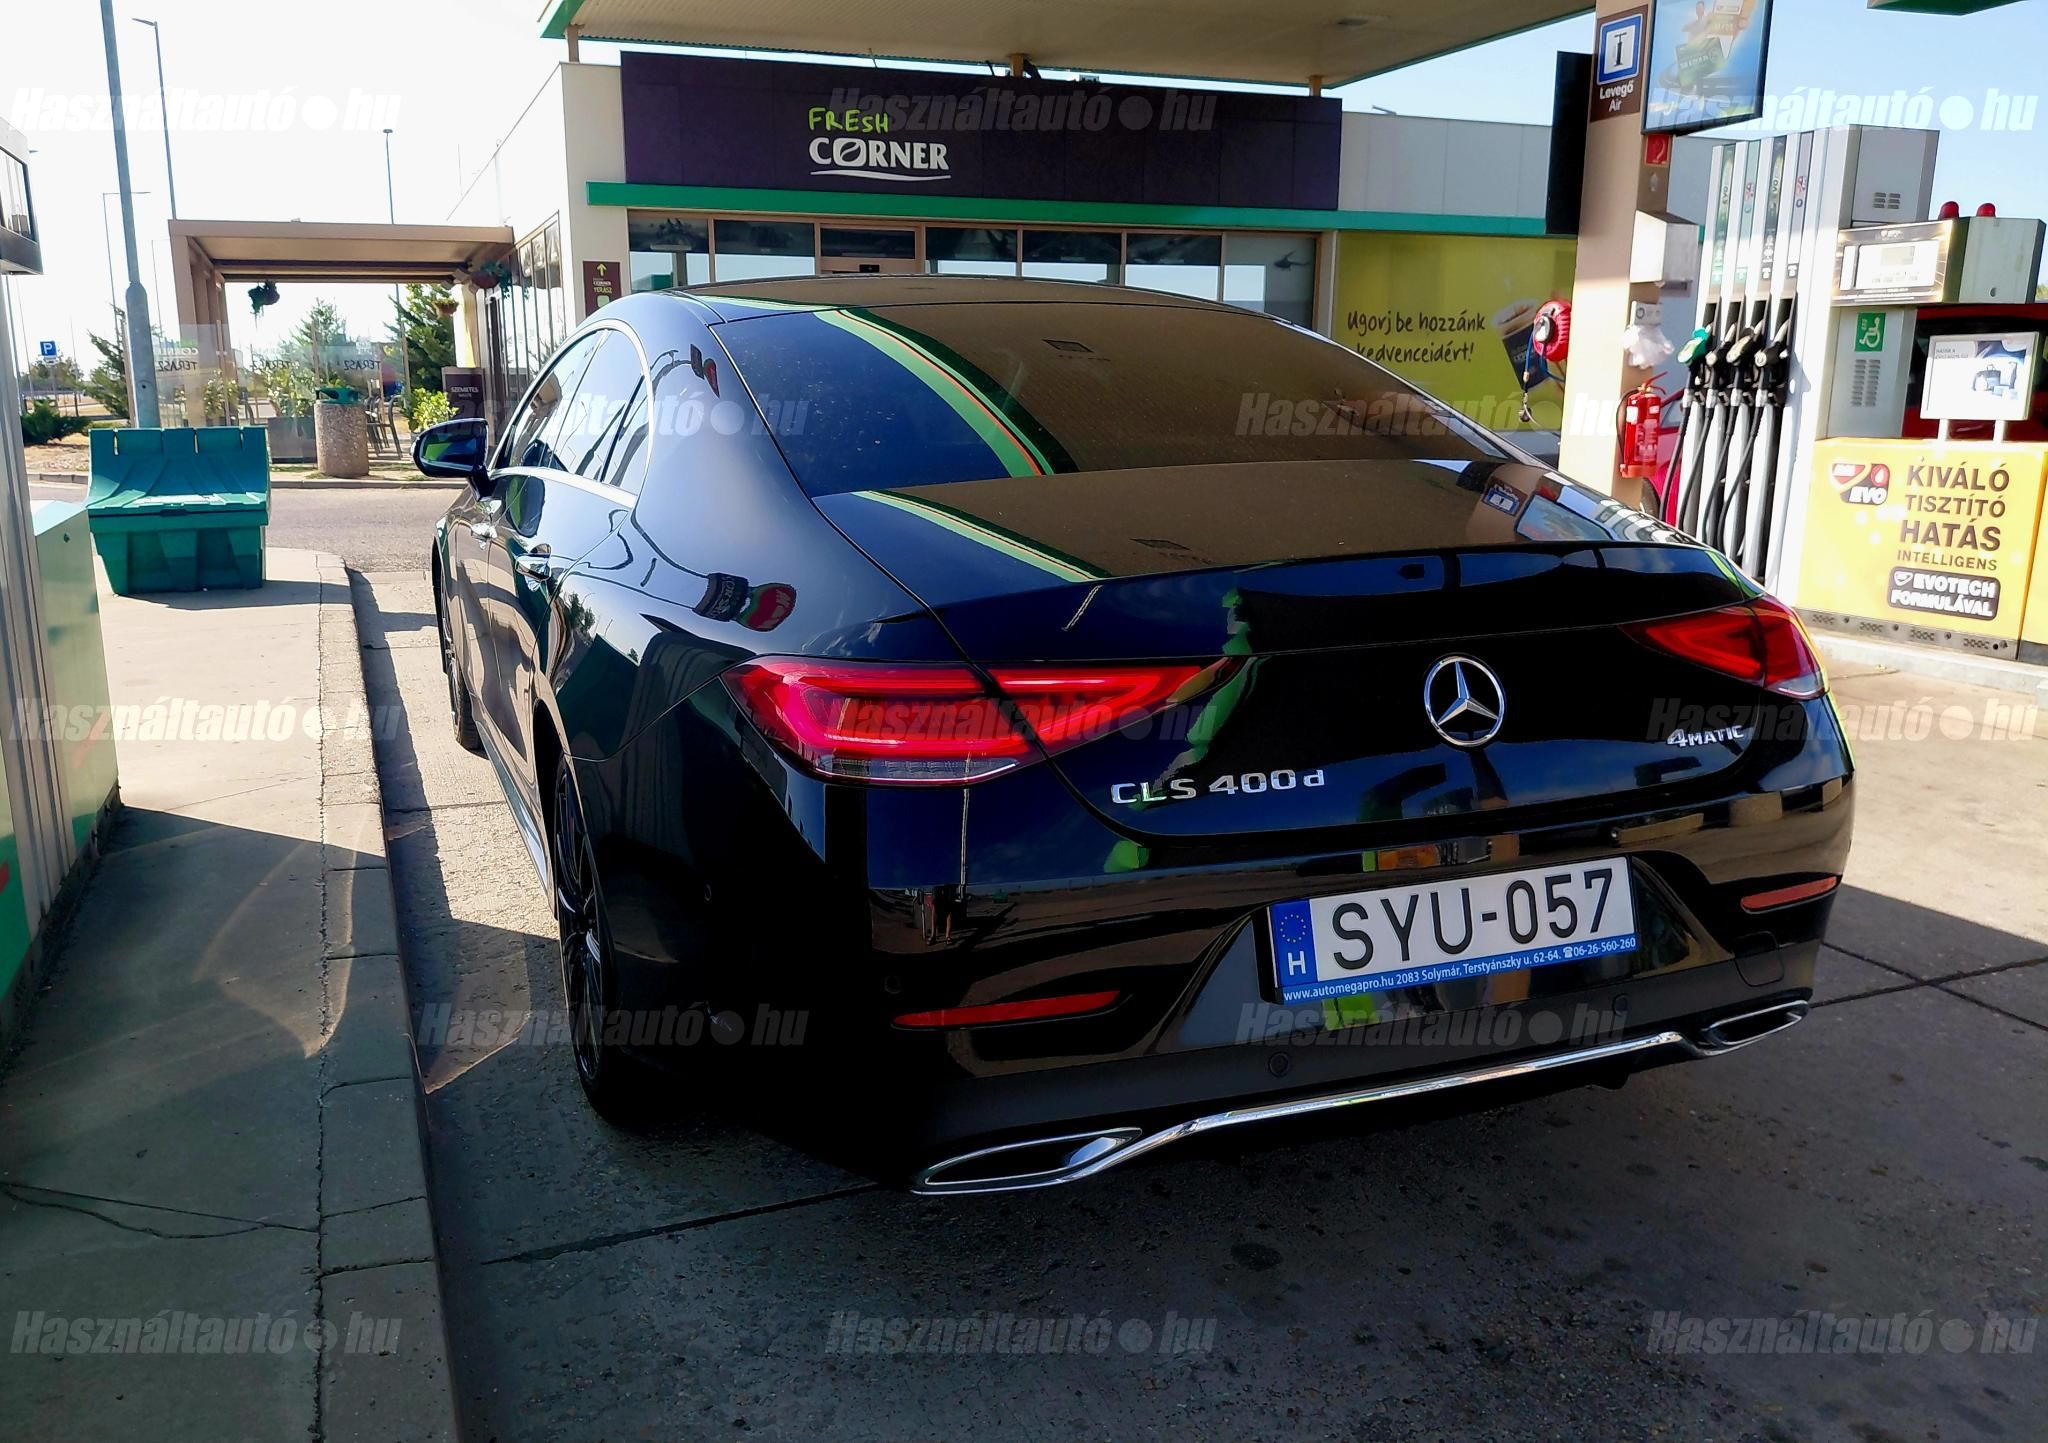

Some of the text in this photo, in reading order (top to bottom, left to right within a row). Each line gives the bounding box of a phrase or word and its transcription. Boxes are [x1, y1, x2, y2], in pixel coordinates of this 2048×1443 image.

[1600, 80, 1634, 100] Levegő
[1608, 99, 1623, 112] Air
[808, 107, 889, 134] FRESH
[808, 137, 950, 170] CORNER
[1347, 310, 1486, 337] Ugorj be hozzánk
[43, 342, 53, 355] P
[1356, 342, 1475, 363] kedvenceidért!
[1906, 461, 2010, 492] KIVÁLÓ
[1904, 493, 2006, 518] TISZTÍTÓ
[1899, 518, 2001, 551] HATÁS
[1896, 549, 1998, 571] INTELLIGENS
[1912, 573, 1996, 598] EVOTECH
[1890, 588, 1994, 616] FORMULÁVAL
[1666, 725, 1745, 747] 4MATIC
[1110, 778, 1198, 804] CLS
[1332, 868, 1613, 971] SYU-057
[1283, 975, 1394, 1001] www.automegapro.hu
[1396, 971, 1420, 985] 2083
[1422, 964, 1462, 984] Solymár,
[1463, 955, 1522, 975] Terstyánszky
[1523, 957, 1533, 966] u.
[1533, 950, 1562, 964] 62-64.
[1287, 950, 1307, 976] H
